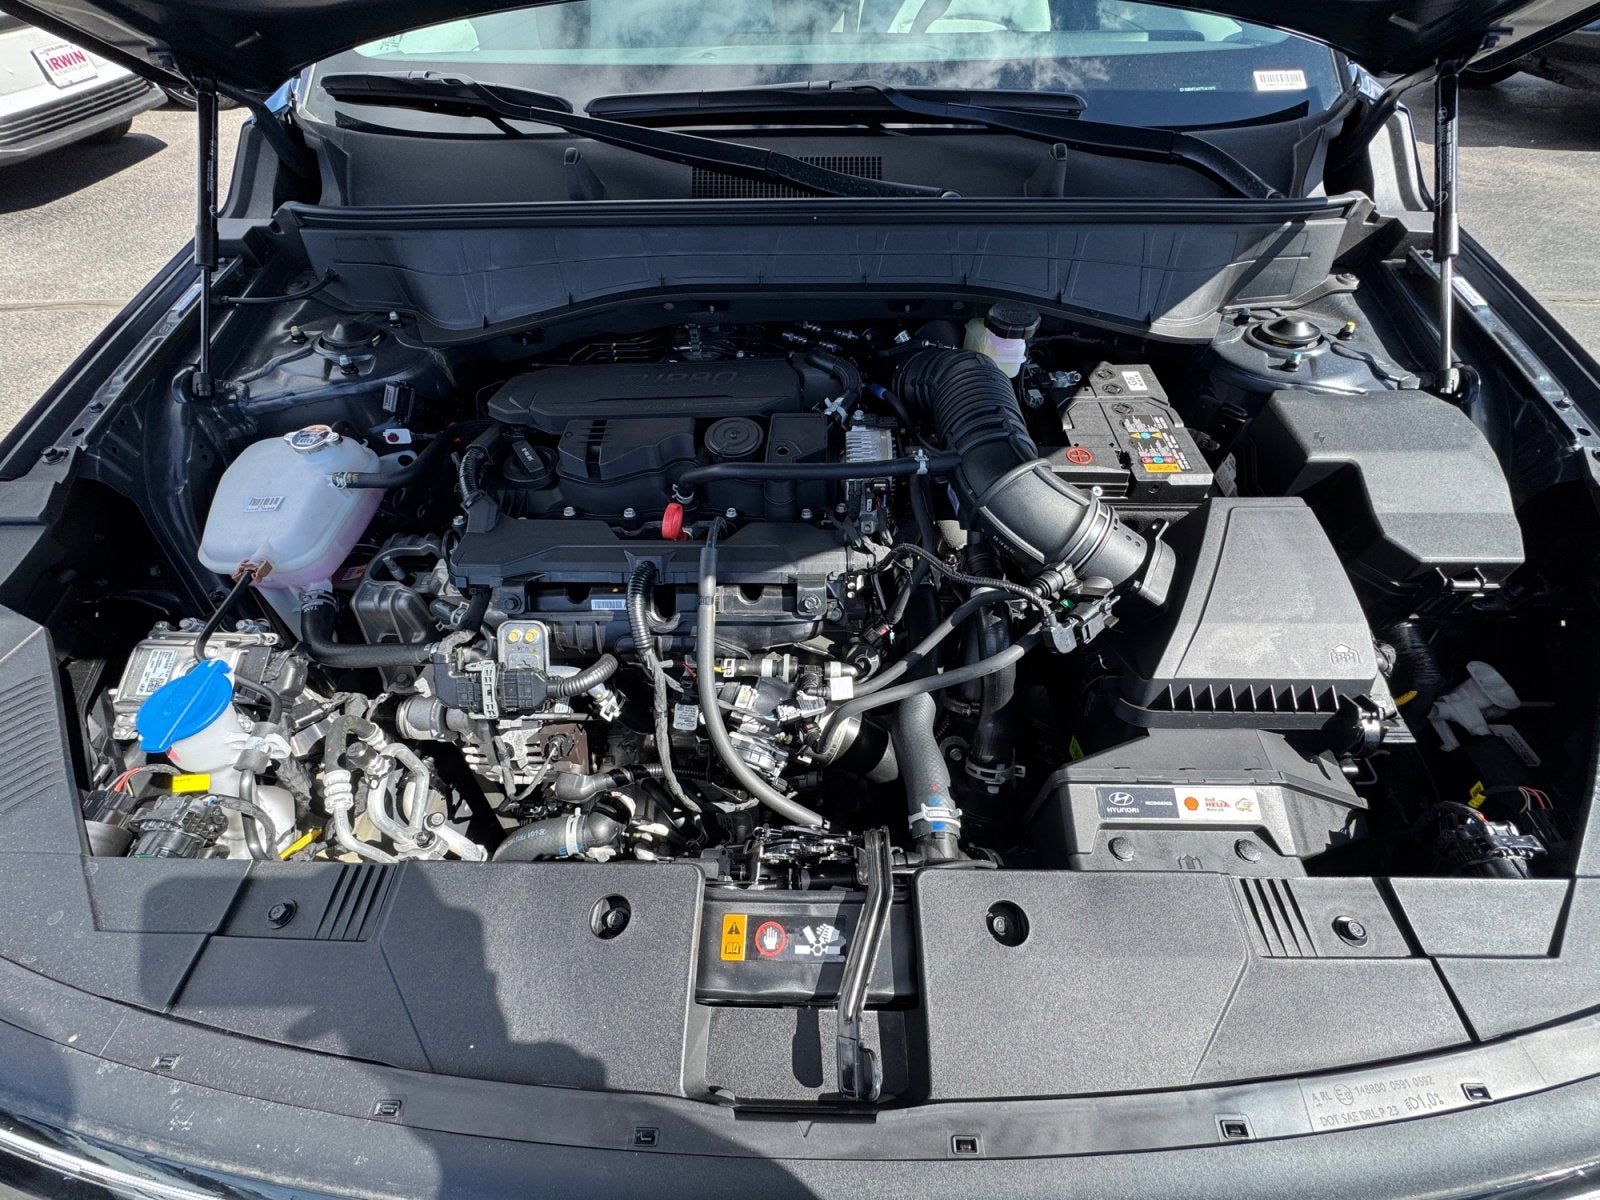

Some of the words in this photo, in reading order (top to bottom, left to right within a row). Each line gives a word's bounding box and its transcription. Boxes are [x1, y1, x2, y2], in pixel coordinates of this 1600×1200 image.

[45, 50, 87, 72] IRWIN
[1319, 1114, 1340, 1127] DOT
[1340, 1111, 1361, 1124] SAE
